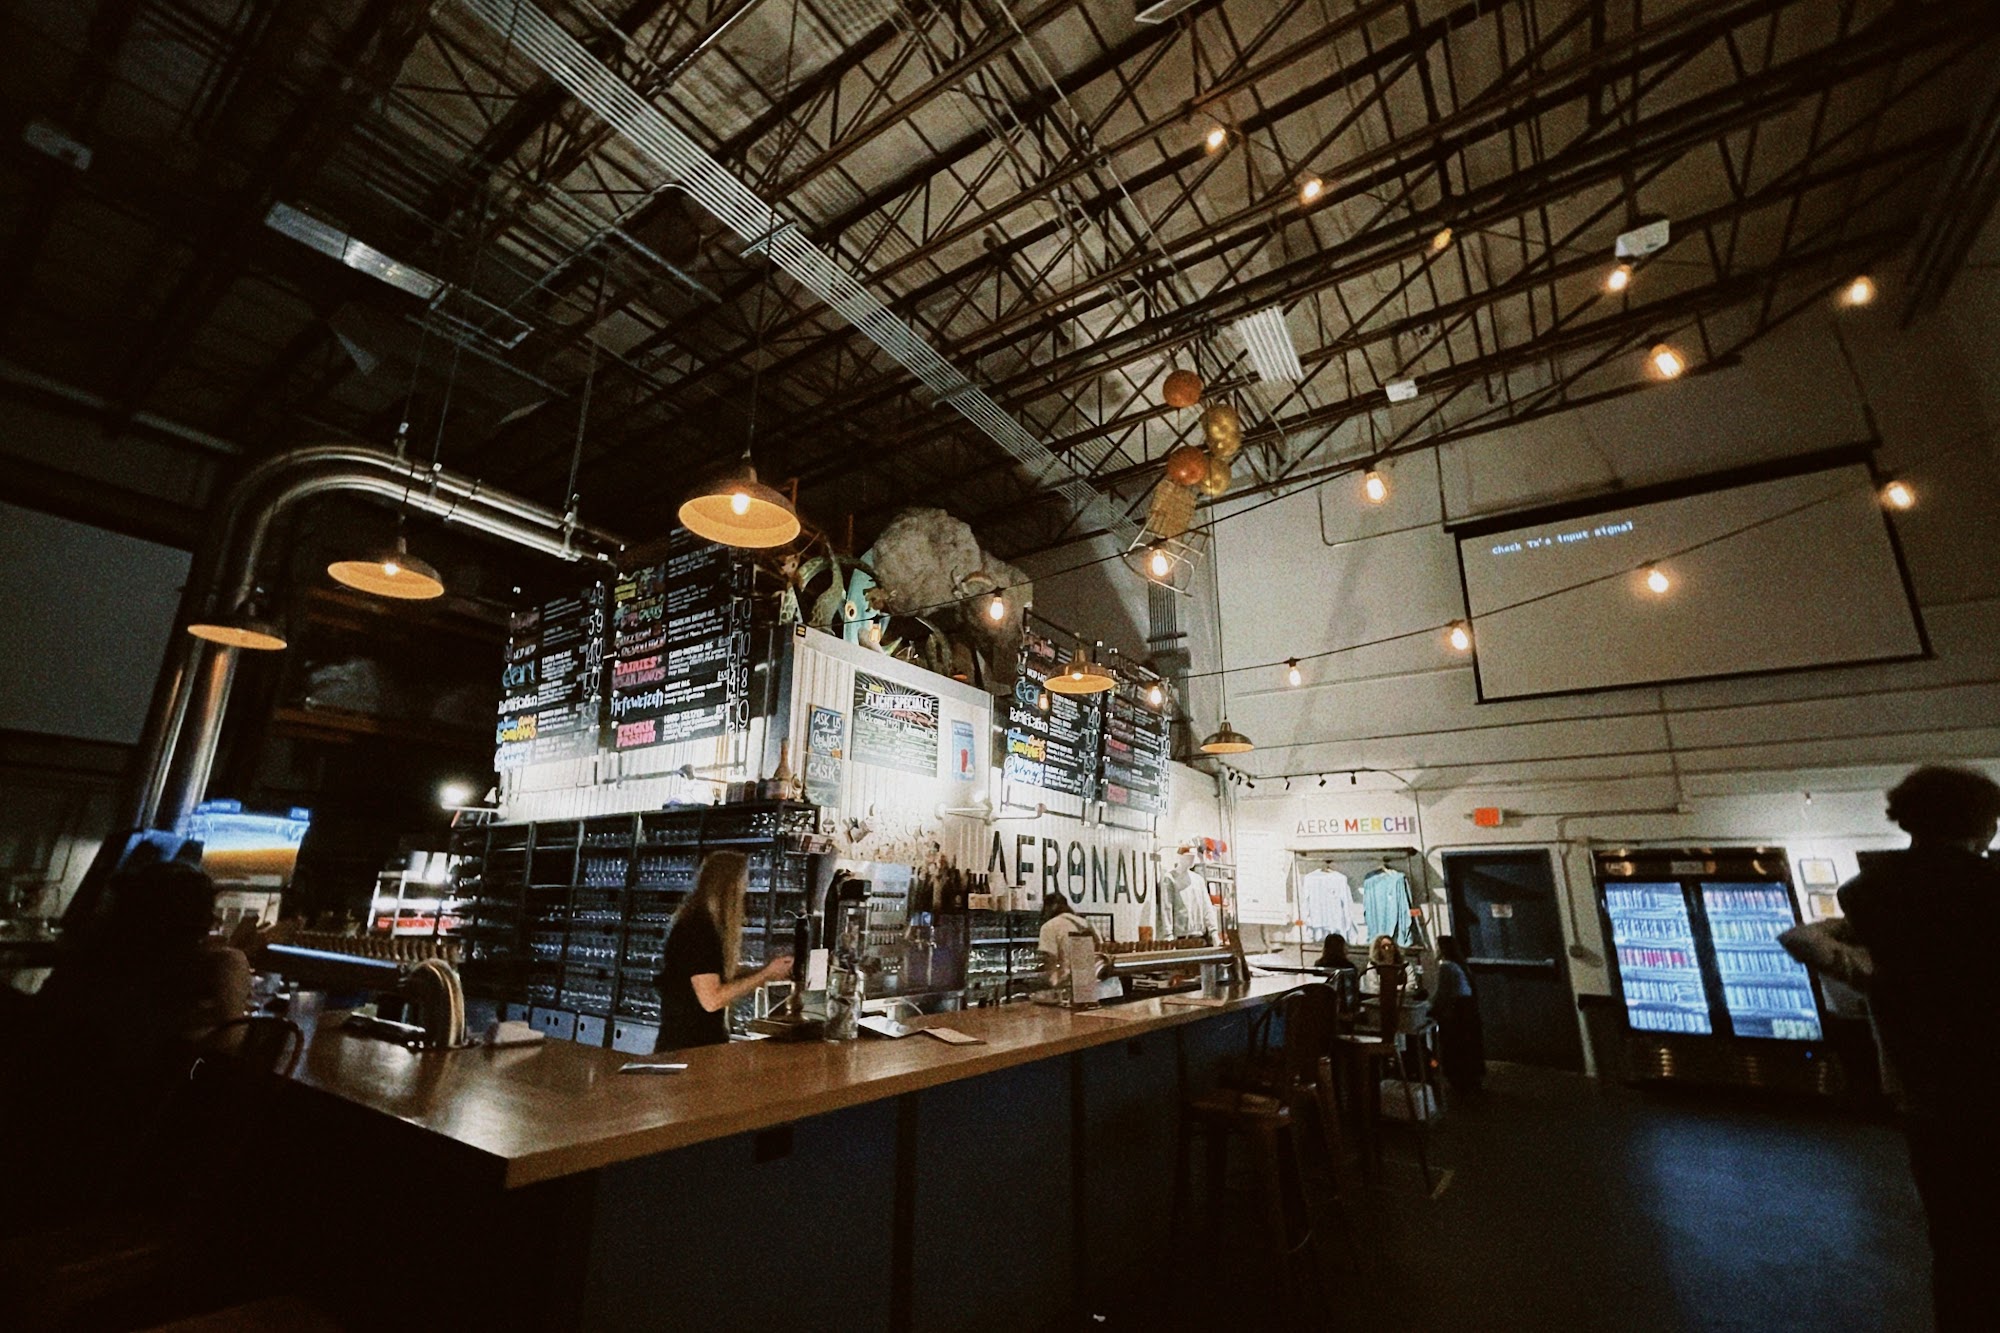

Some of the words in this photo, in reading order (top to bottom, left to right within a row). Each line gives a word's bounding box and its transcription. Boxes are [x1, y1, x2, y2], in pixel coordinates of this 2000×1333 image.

[1491, 541, 1522, 555] Check
[1557, 530, 1589, 544] input
[1594, 520, 1634, 537] signal
[865, 692, 893, 709] FLIGHT
[814, 712, 830, 726] ASK
[832, 716, 842, 730] US
[1296, 818, 1339, 835] AERO
[1345, 816, 1408, 834] MERCH
[988, 830, 1162, 906] AERONAUT
